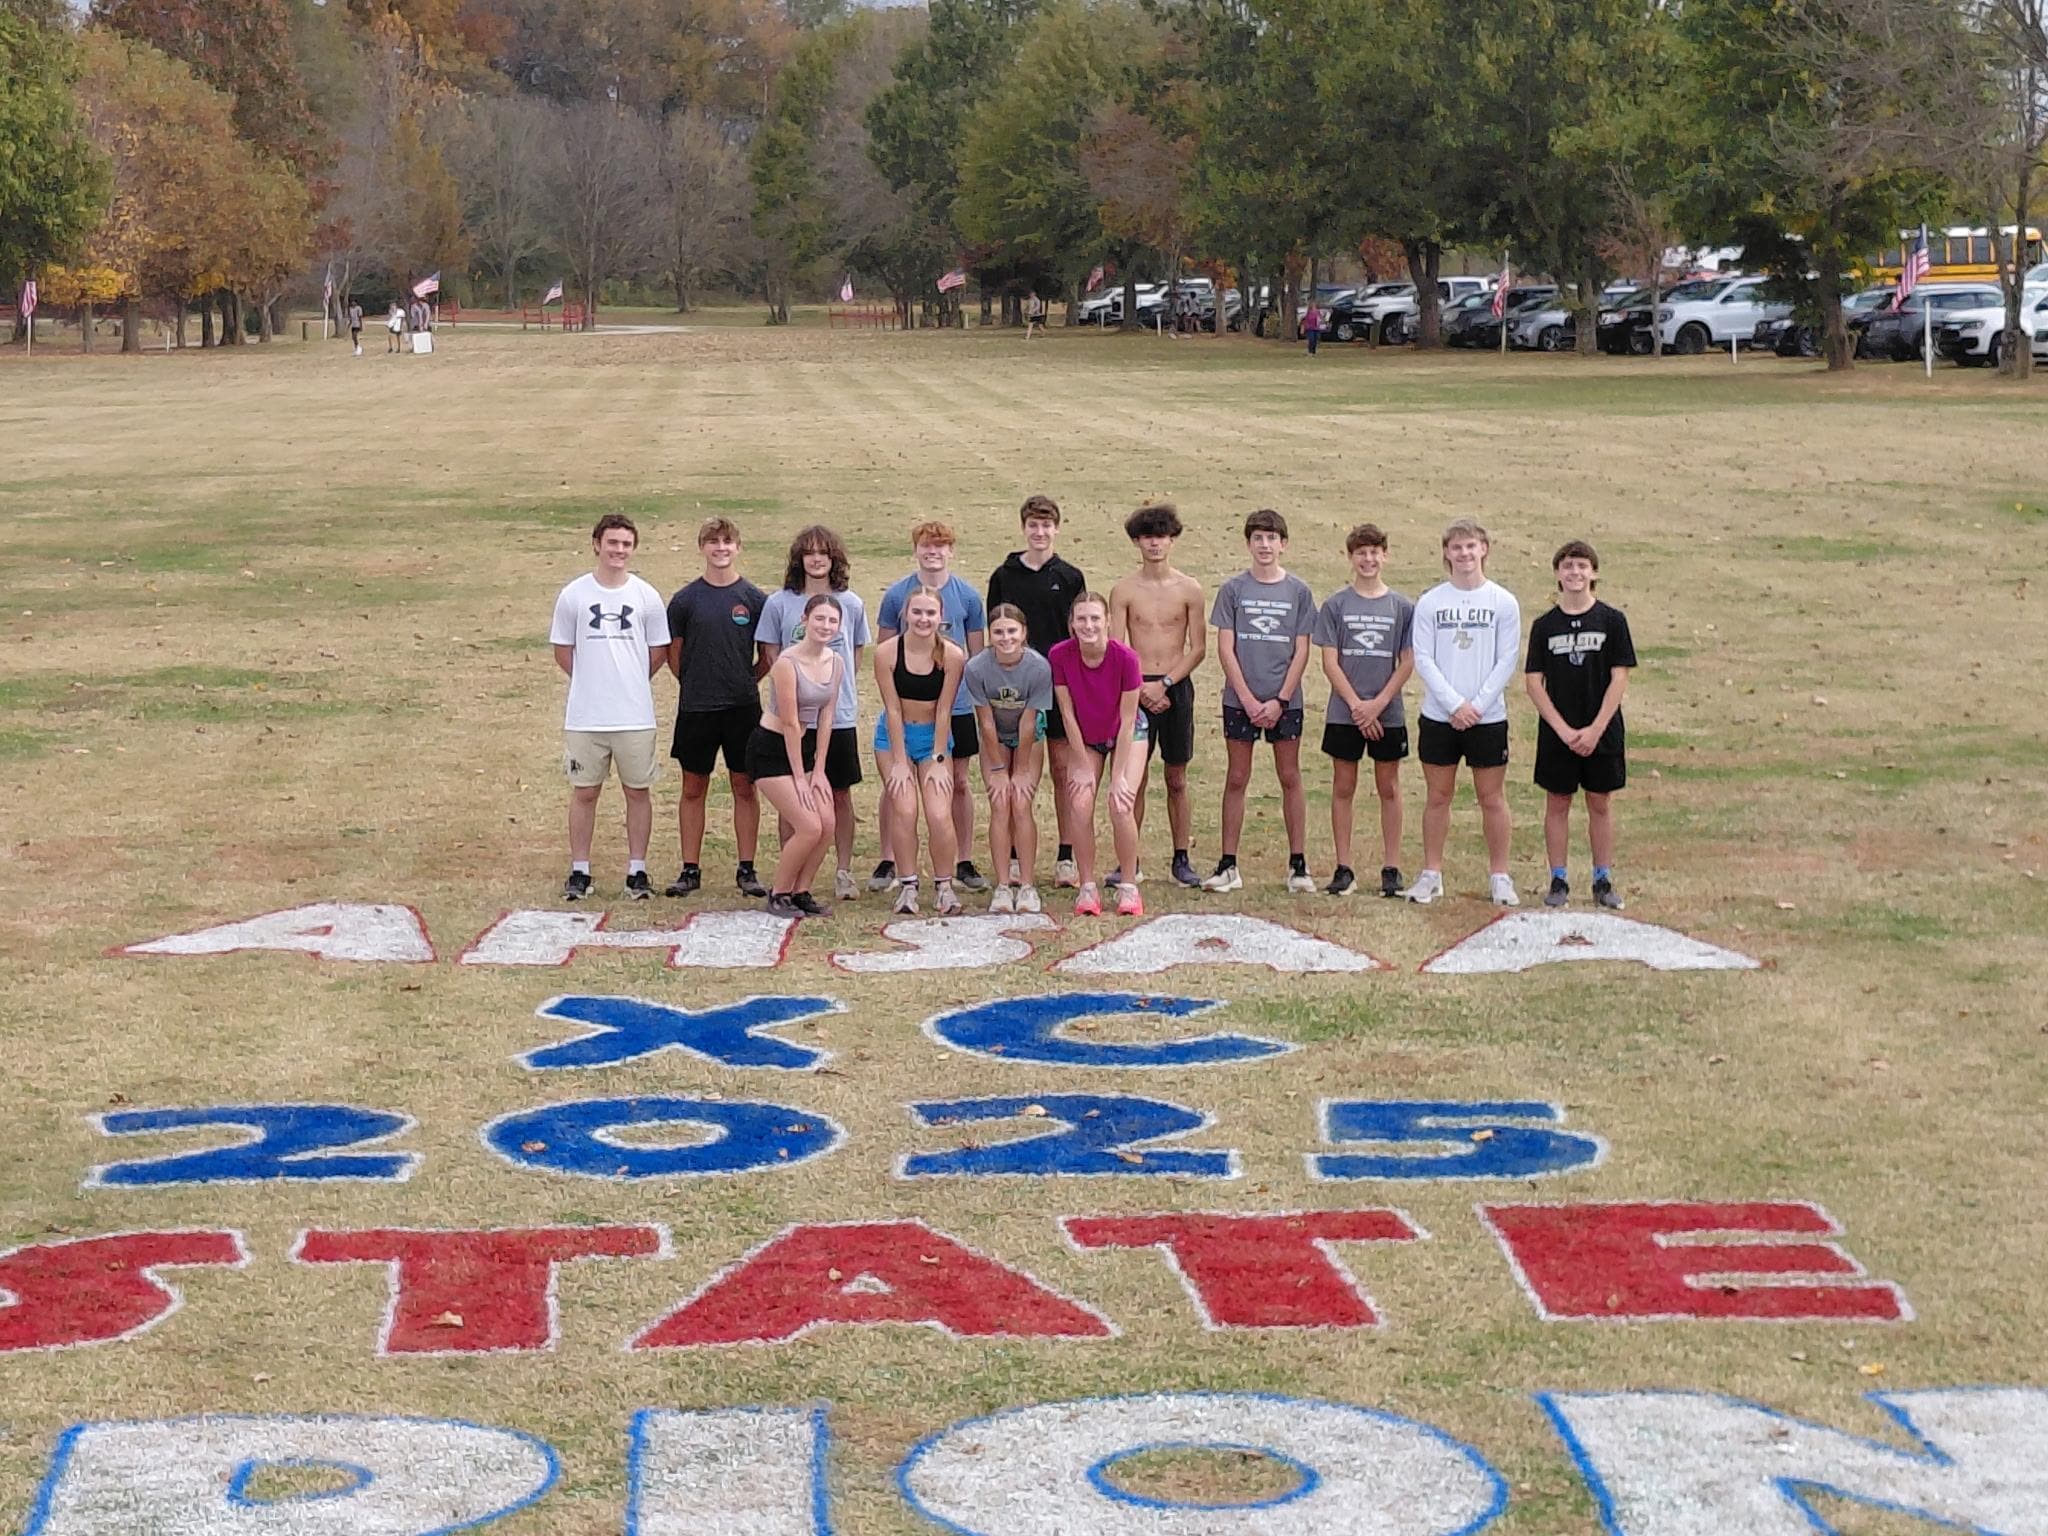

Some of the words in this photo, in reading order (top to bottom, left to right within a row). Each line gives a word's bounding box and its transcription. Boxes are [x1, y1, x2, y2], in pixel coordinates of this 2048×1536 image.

[1468, 608, 1495, 623] CITY
[105, 902, 1774, 974] AHSAA
[512, 993, 1302, 1071] XC
[84, 1094, 1612, 1188] 2025
[0, 1199, 1915, 1357] STATE
